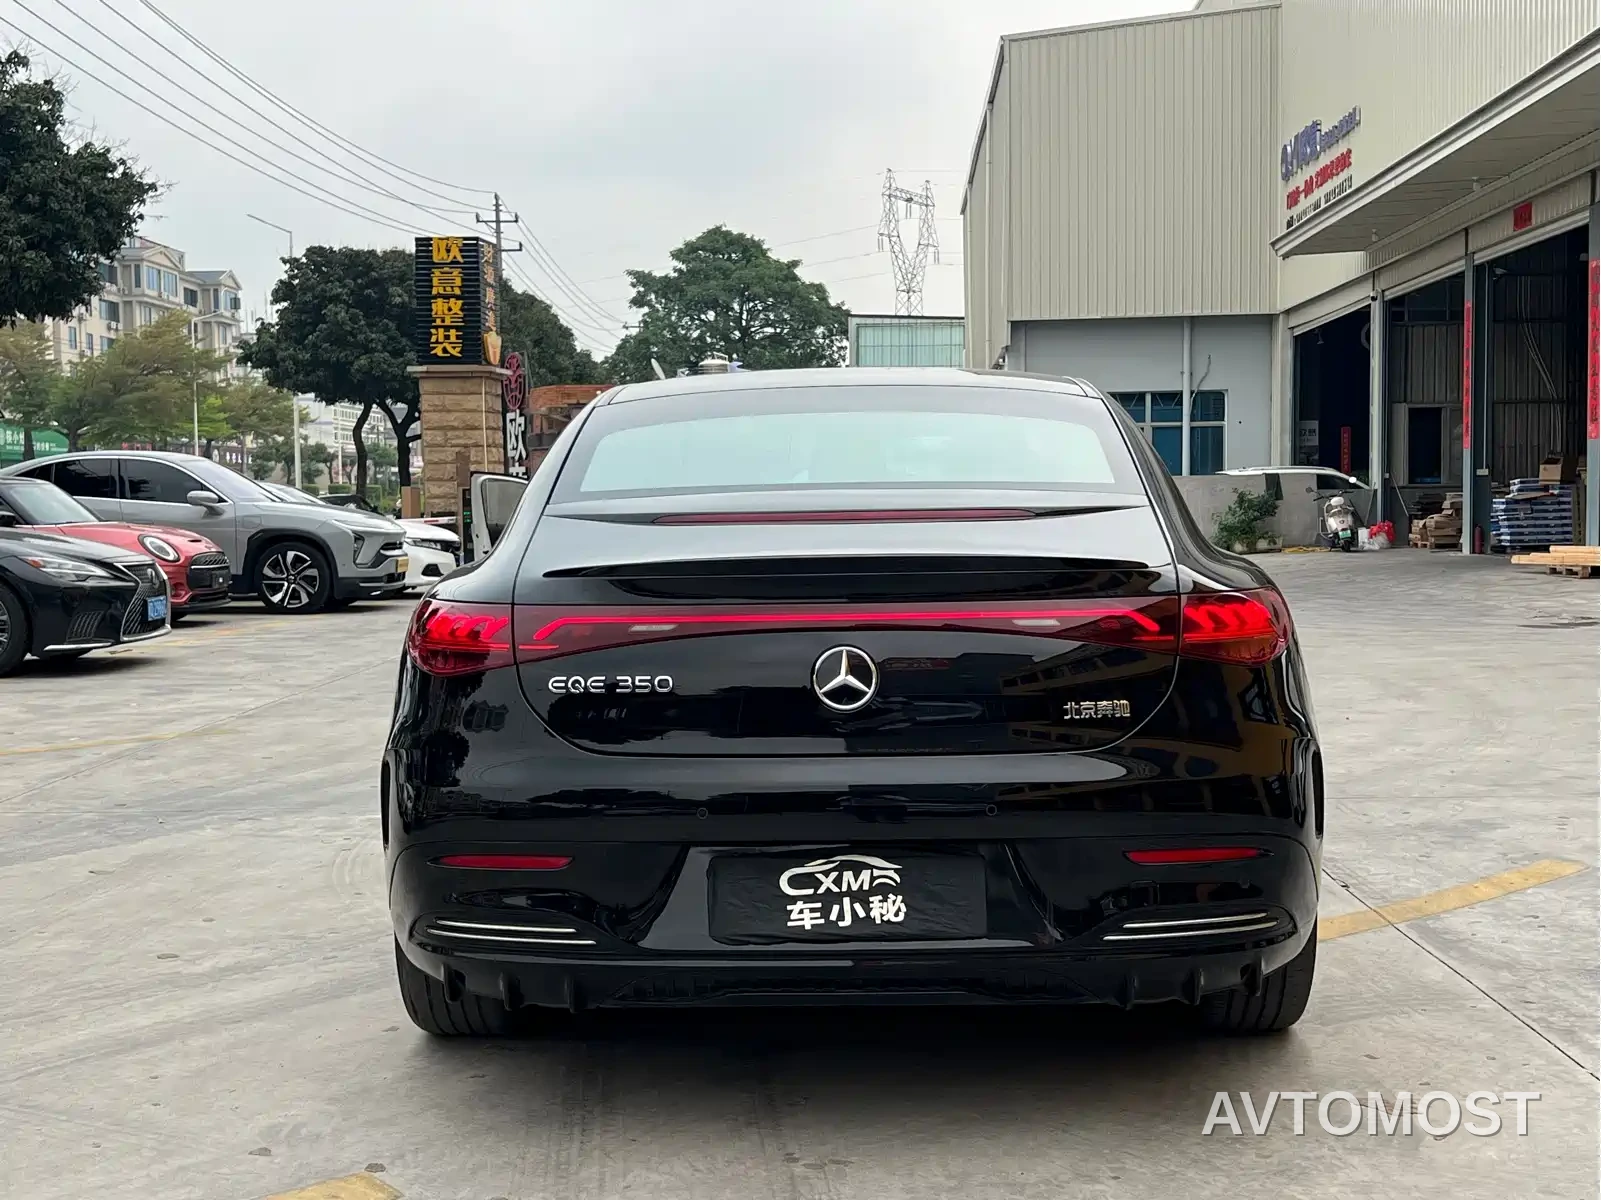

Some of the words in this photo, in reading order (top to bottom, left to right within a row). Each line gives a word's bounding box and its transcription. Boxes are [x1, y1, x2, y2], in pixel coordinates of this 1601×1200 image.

[430, 237, 464, 356] 欧意整装
[548, 675, 606, 694] EQE
[616, 675, 674, 693] 350
[1063, 699, 1131, 720] 北京奔驰
[786, 893, 907, 930] 车小秘
